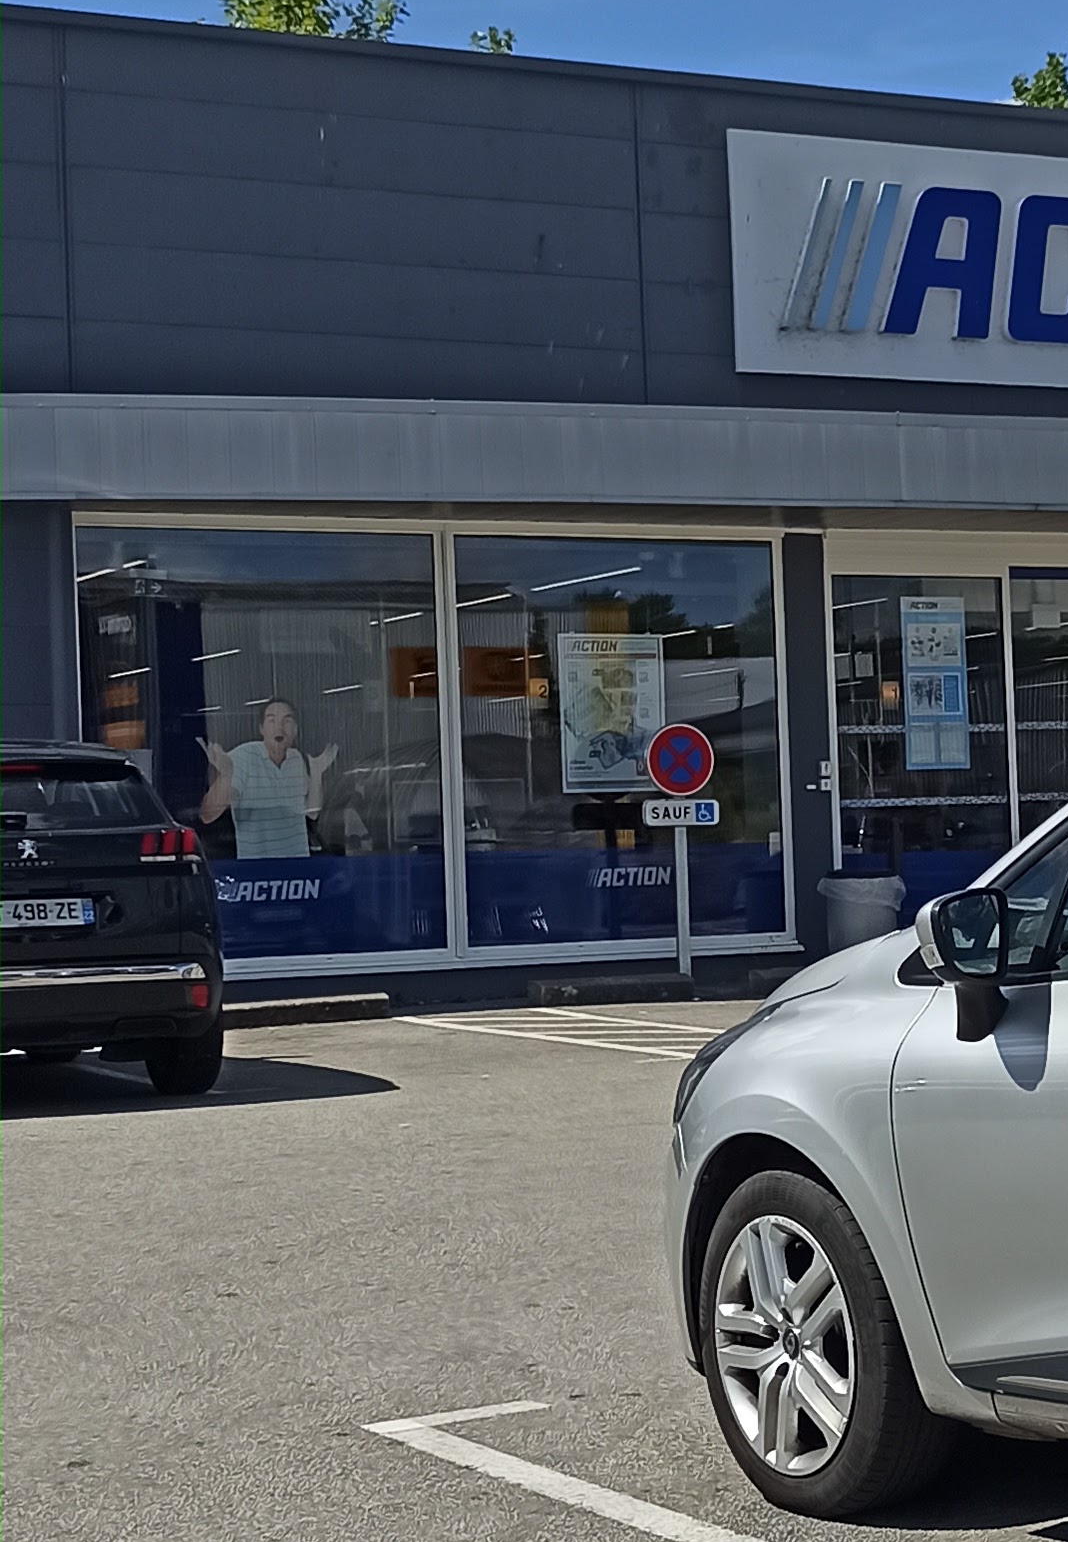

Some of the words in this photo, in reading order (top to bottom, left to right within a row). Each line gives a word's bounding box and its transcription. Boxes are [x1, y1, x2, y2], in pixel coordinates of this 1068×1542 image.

[571, 640, 619, 652] ACTION
[651, 806, 691, 820] SAUF
[597, 866, 672, 888] ACTION
[235, 879, 320, 901] ACTION
[0, 902, 79, 921] -498-ZE
